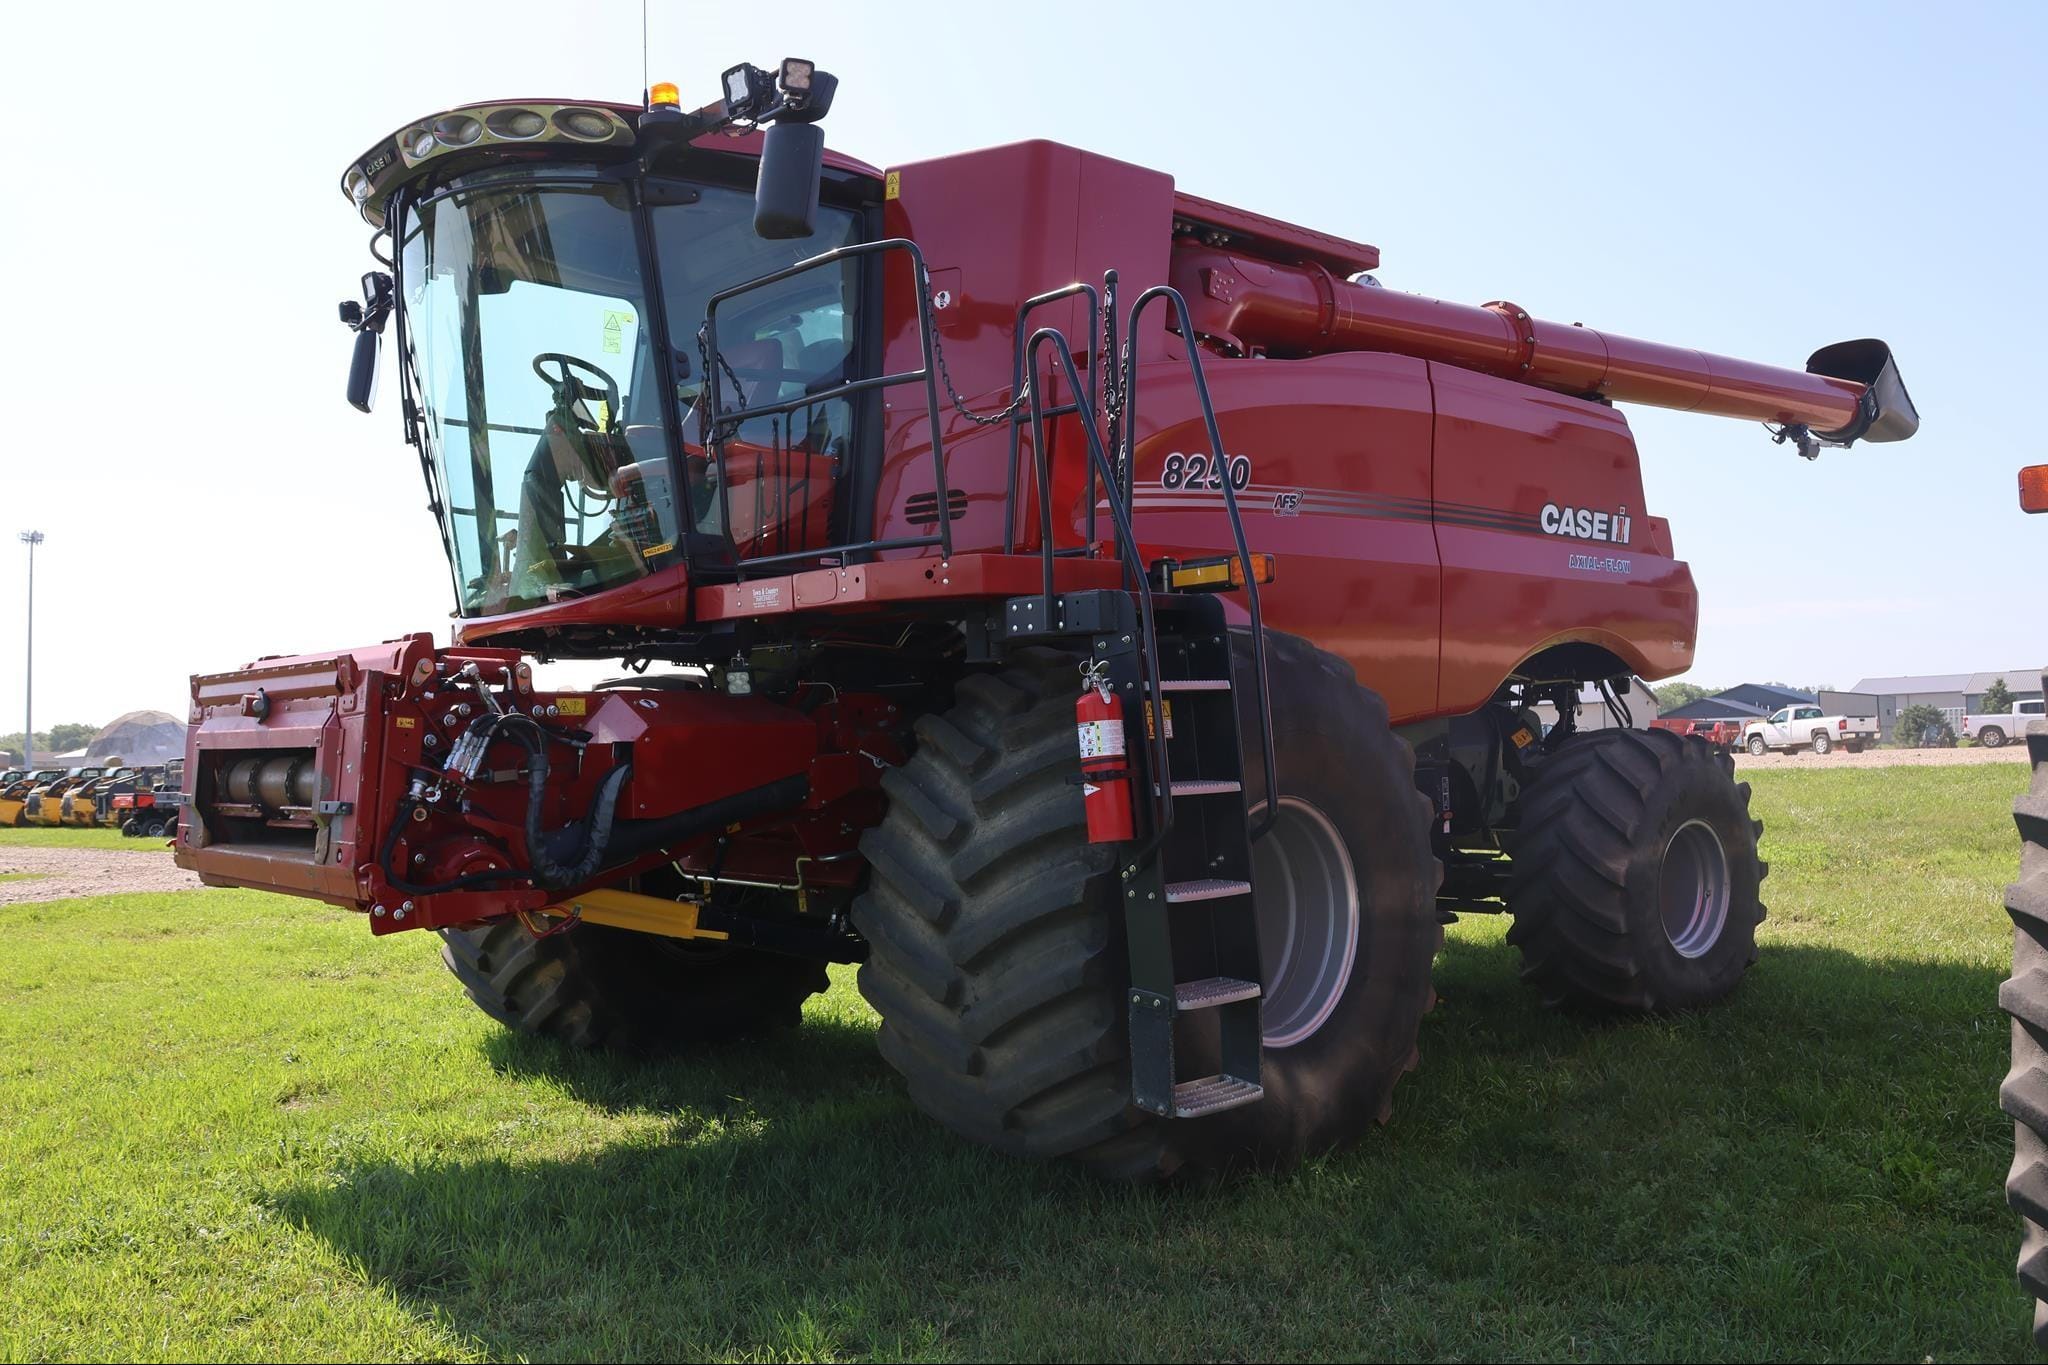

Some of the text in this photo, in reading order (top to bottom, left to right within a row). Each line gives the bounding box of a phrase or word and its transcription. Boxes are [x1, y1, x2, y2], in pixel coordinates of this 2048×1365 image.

[1161, 452, 1251, 491] 8250
[1273, 493, 1299, 510] AFS
[1540, 503, 1609, 540] CASE
[1568, 554, 1631, 574] AXIAL-FLOW
